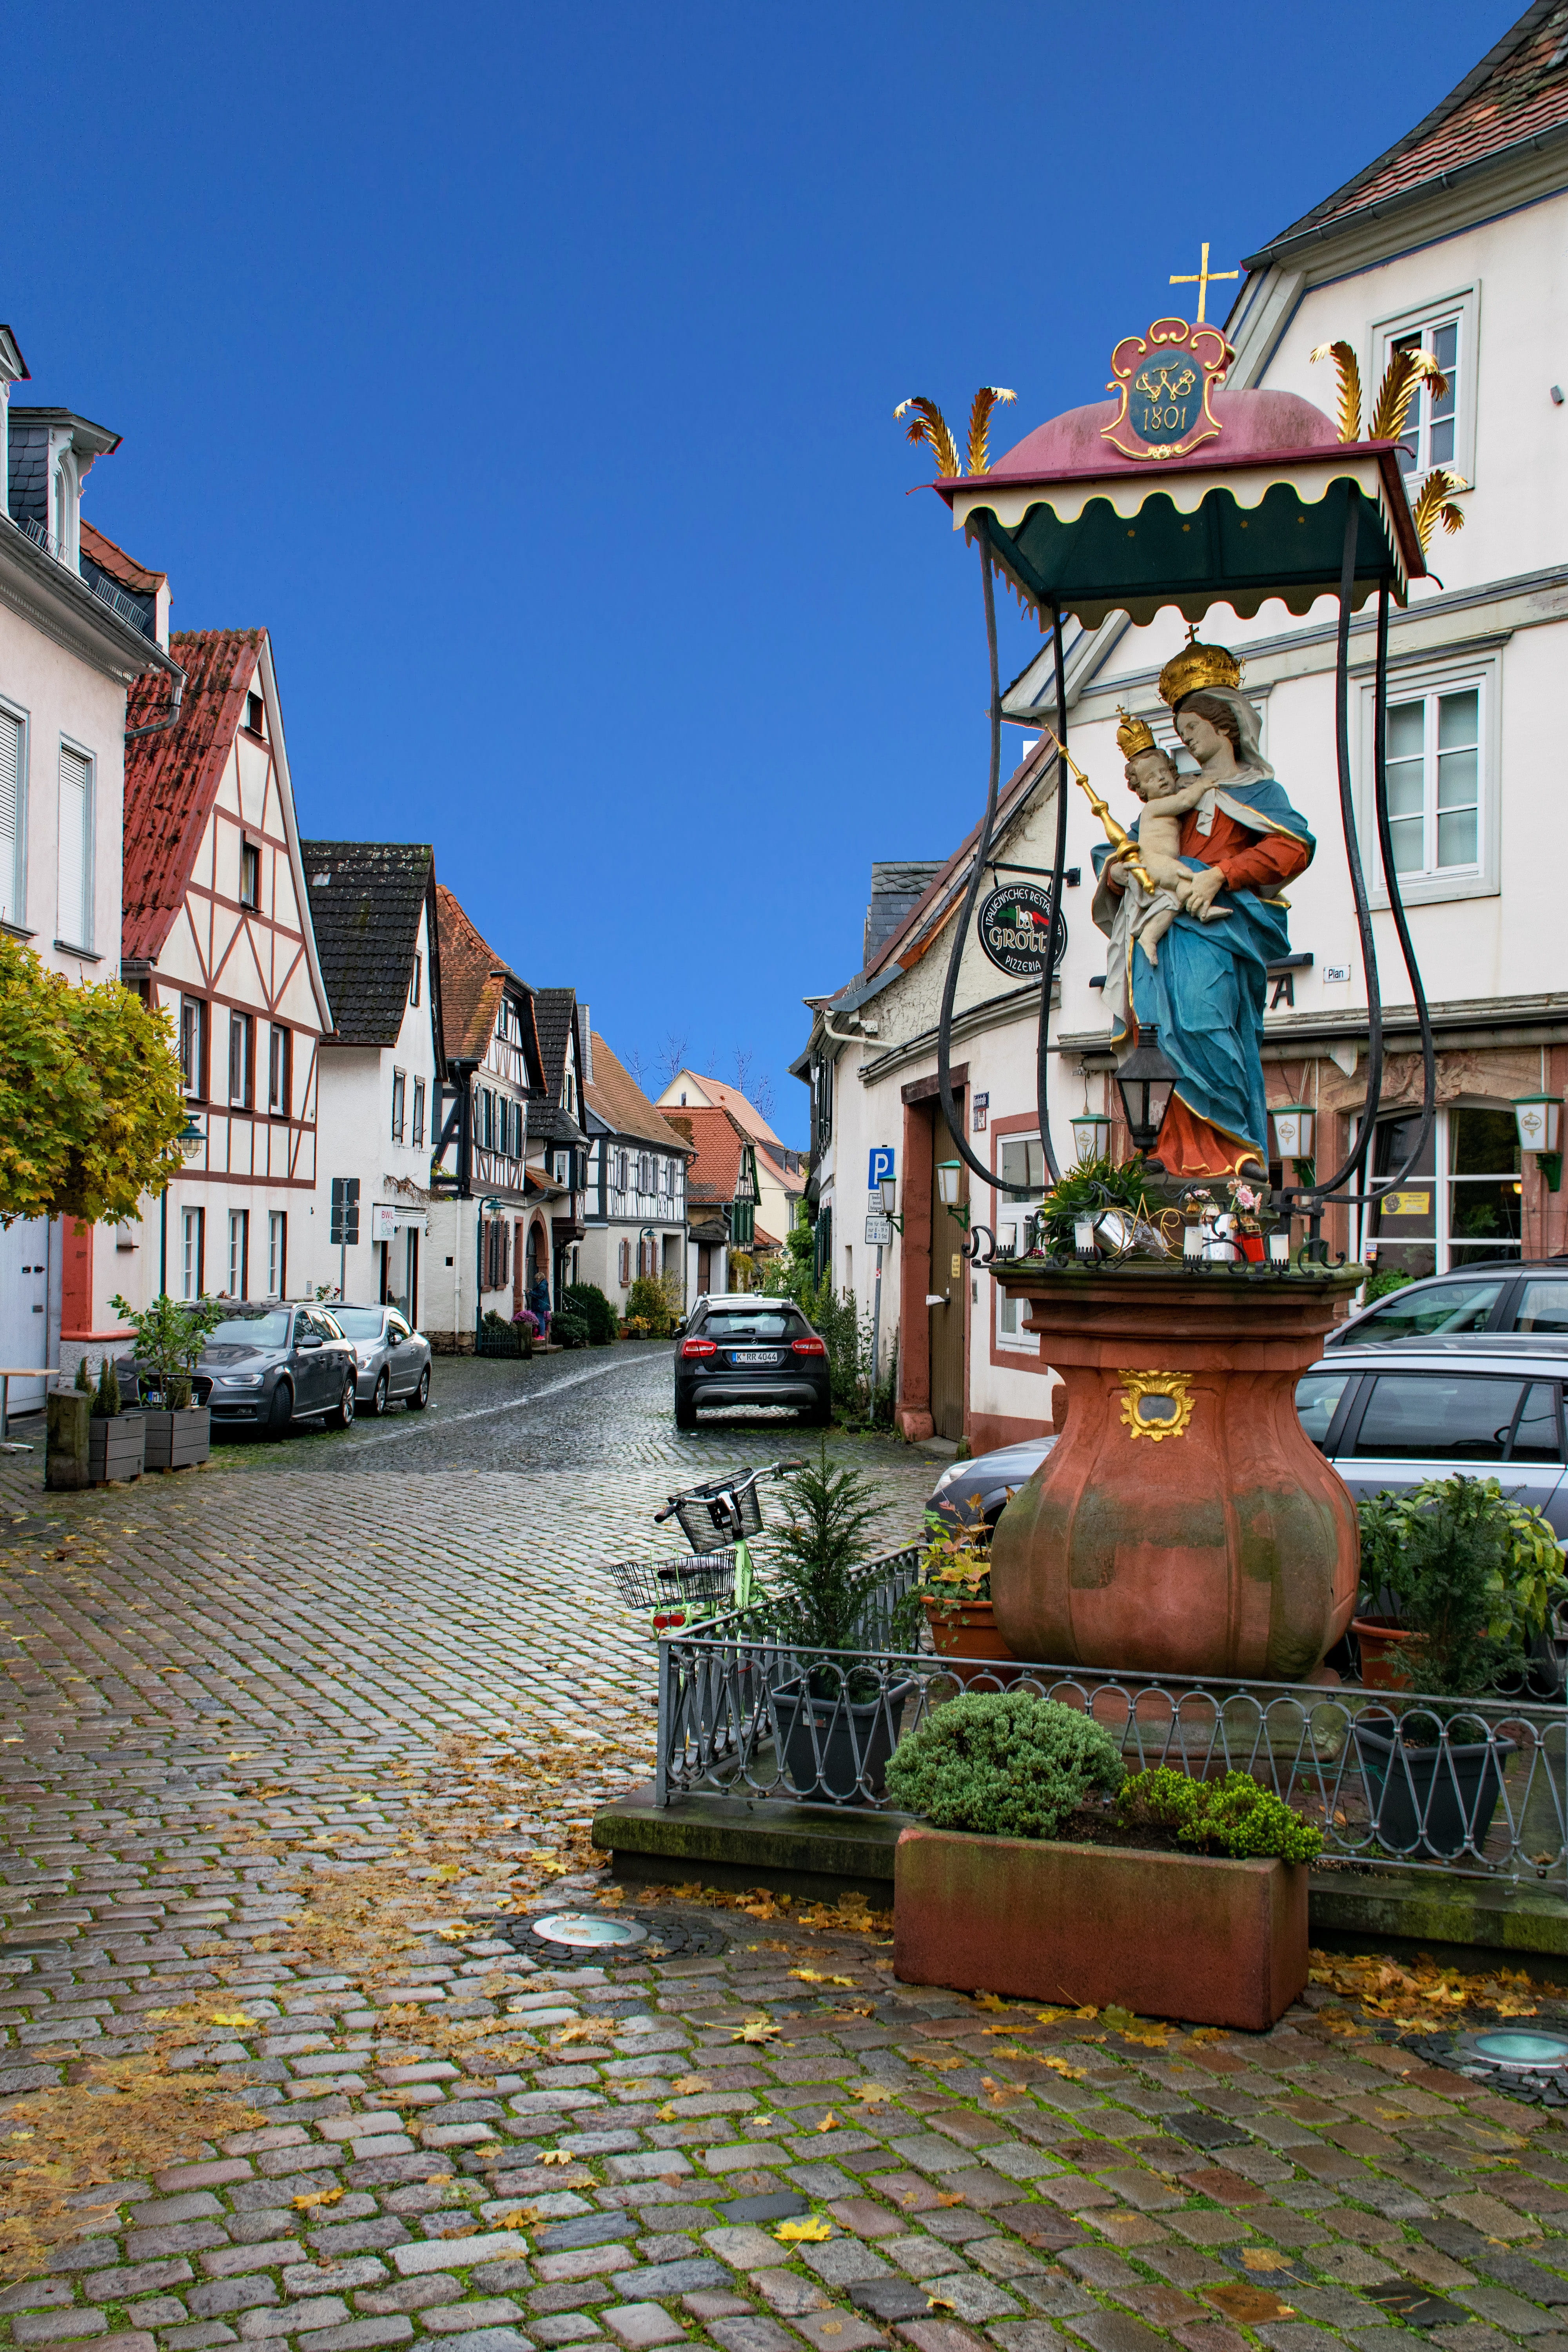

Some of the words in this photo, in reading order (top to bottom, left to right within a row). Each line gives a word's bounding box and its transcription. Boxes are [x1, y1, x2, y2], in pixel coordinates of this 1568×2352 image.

[1144, 407, 1186, 432] 1801
[985, 888, 1029, 926] ITALIENISCHES
[989, 927, 1058, 953] GROTT
[1005, 955, 1041, 972] PIZZERIA
[1328, 969, 1343, 979] Plan
[874, 1153, 889, 1185] P
[381, 1210, 394, 1219] BWL
